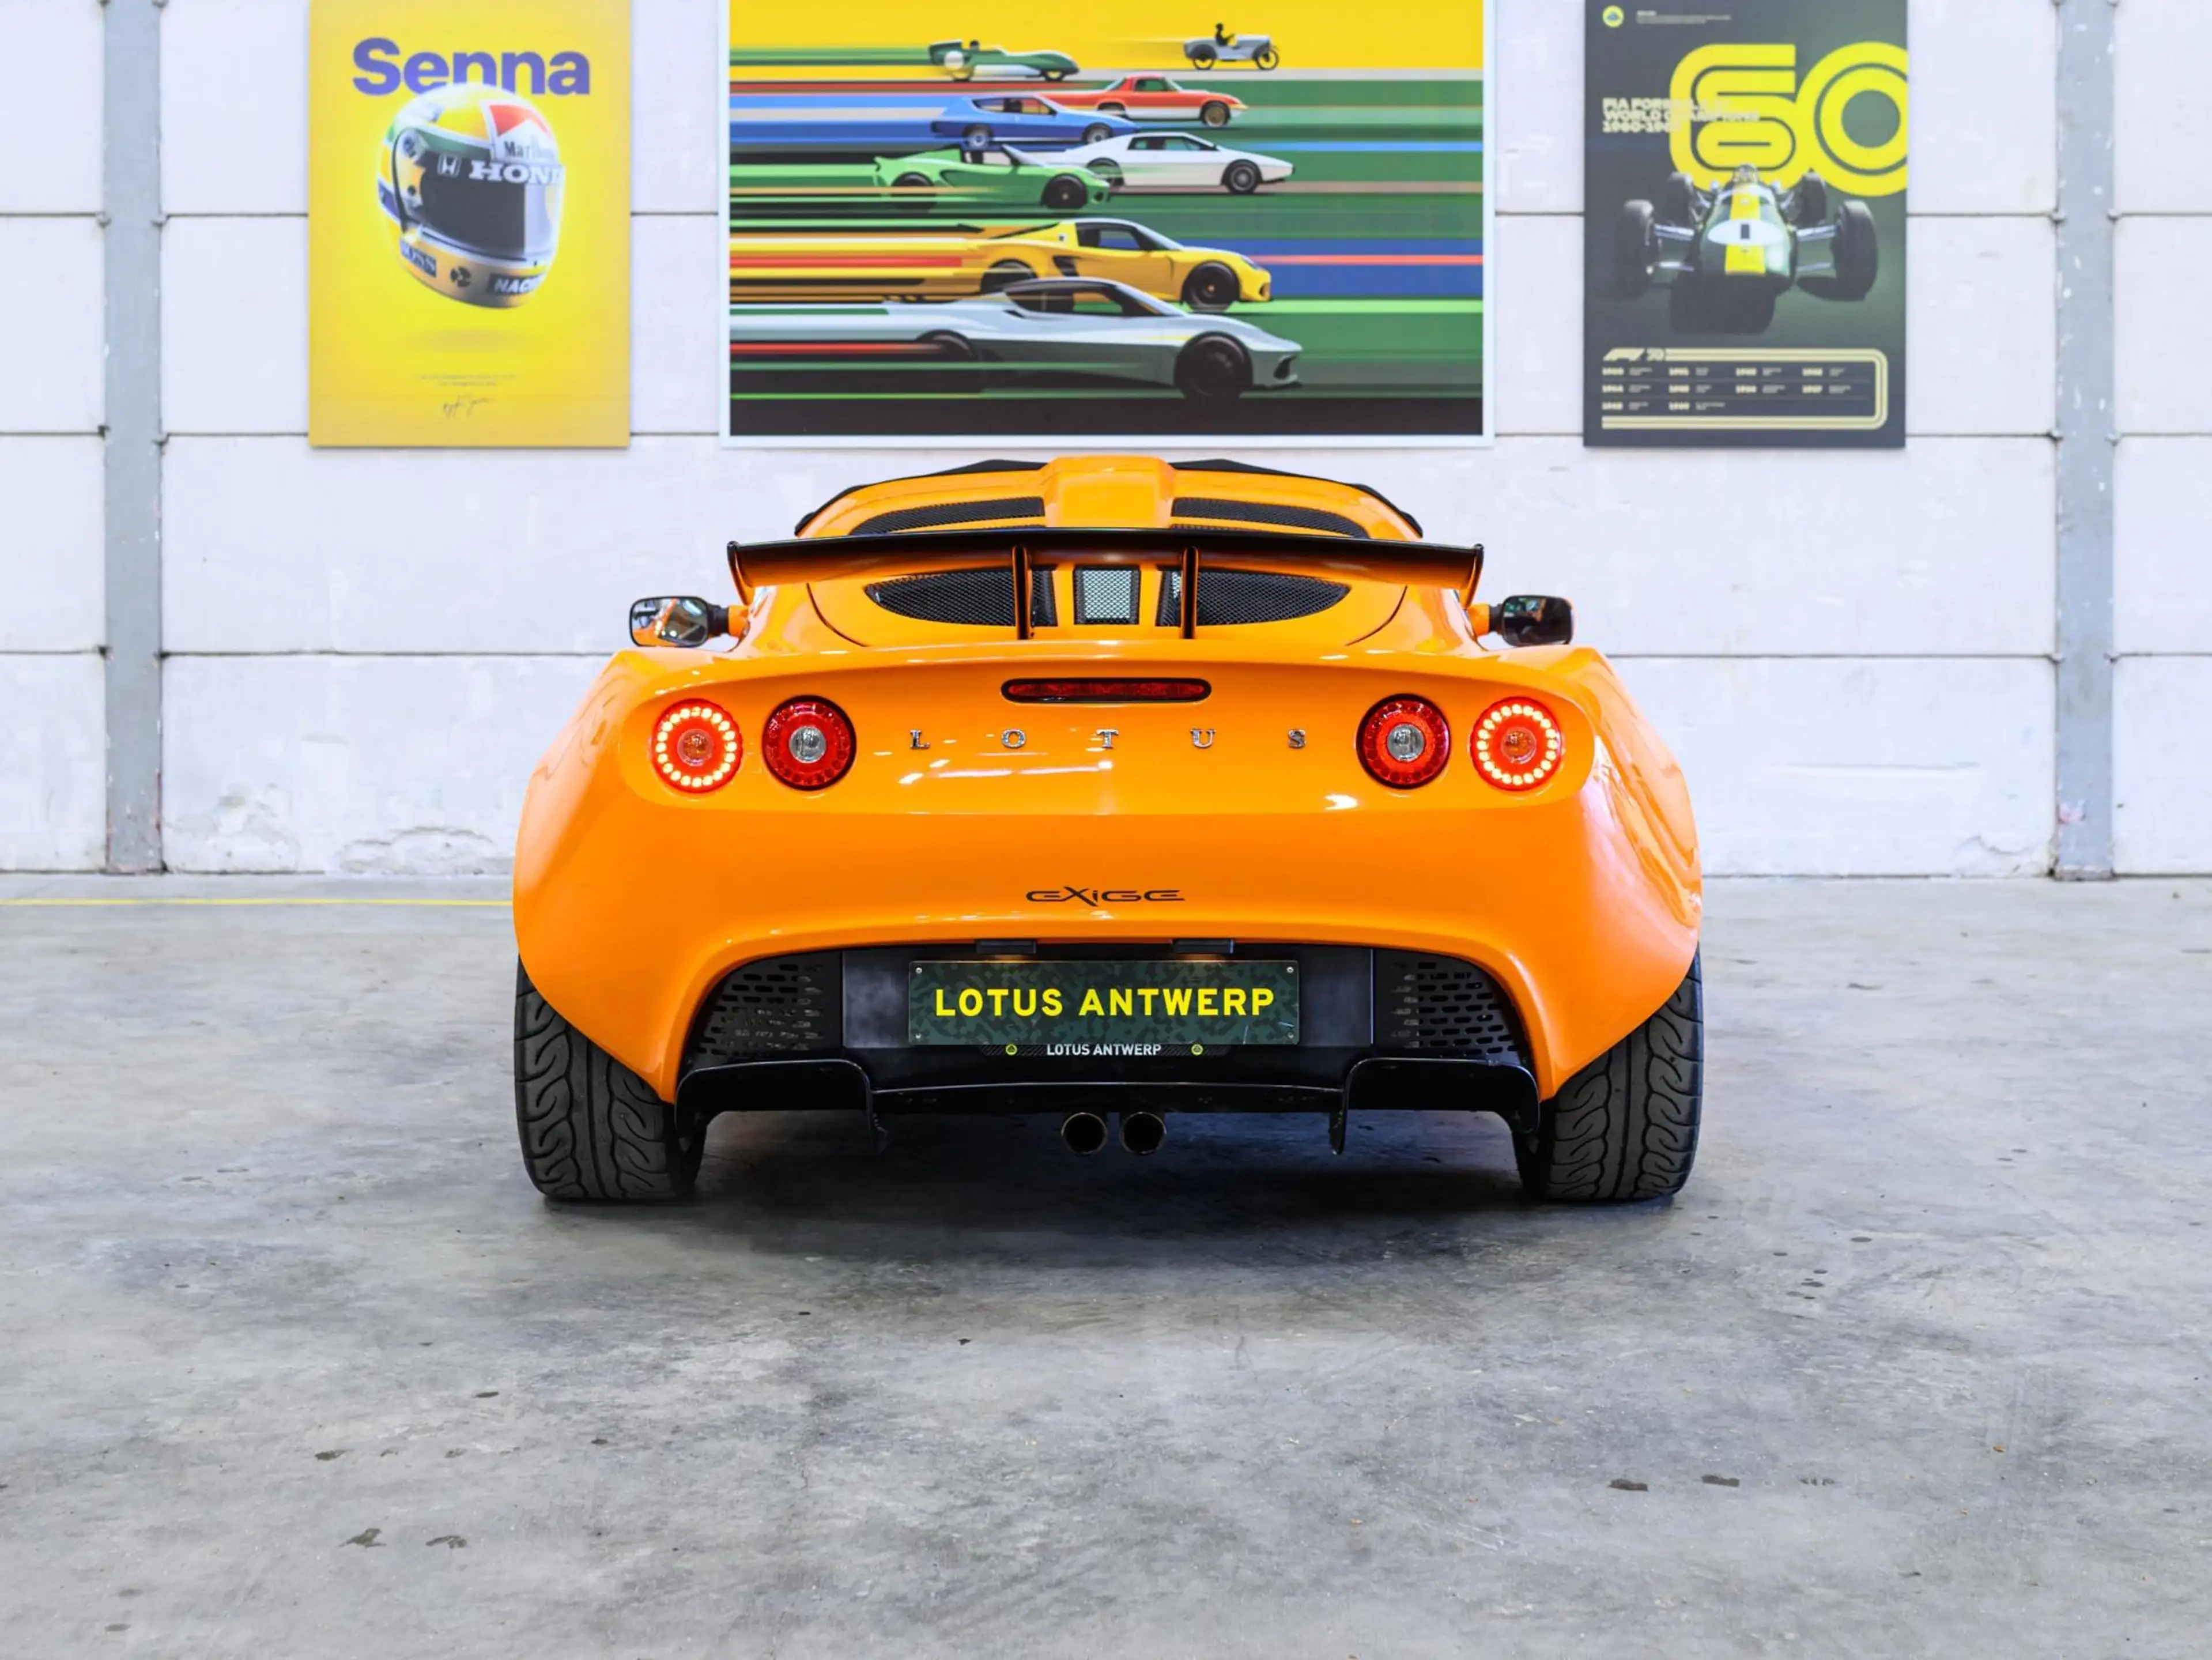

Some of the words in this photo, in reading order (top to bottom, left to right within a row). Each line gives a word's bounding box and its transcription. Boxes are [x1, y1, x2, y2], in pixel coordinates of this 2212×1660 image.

[353, 37, 590, 96] Senna
[910, 728, 1307, 750] LOTUS
[936, 988, 1063, 1017] LOTUS
[1078, 988, 1274, 1016] ANTWERP
[1047, 1044, 1090, 1056] LOTUS
[1093, 1044, 1162, 1056] ANTWERP
